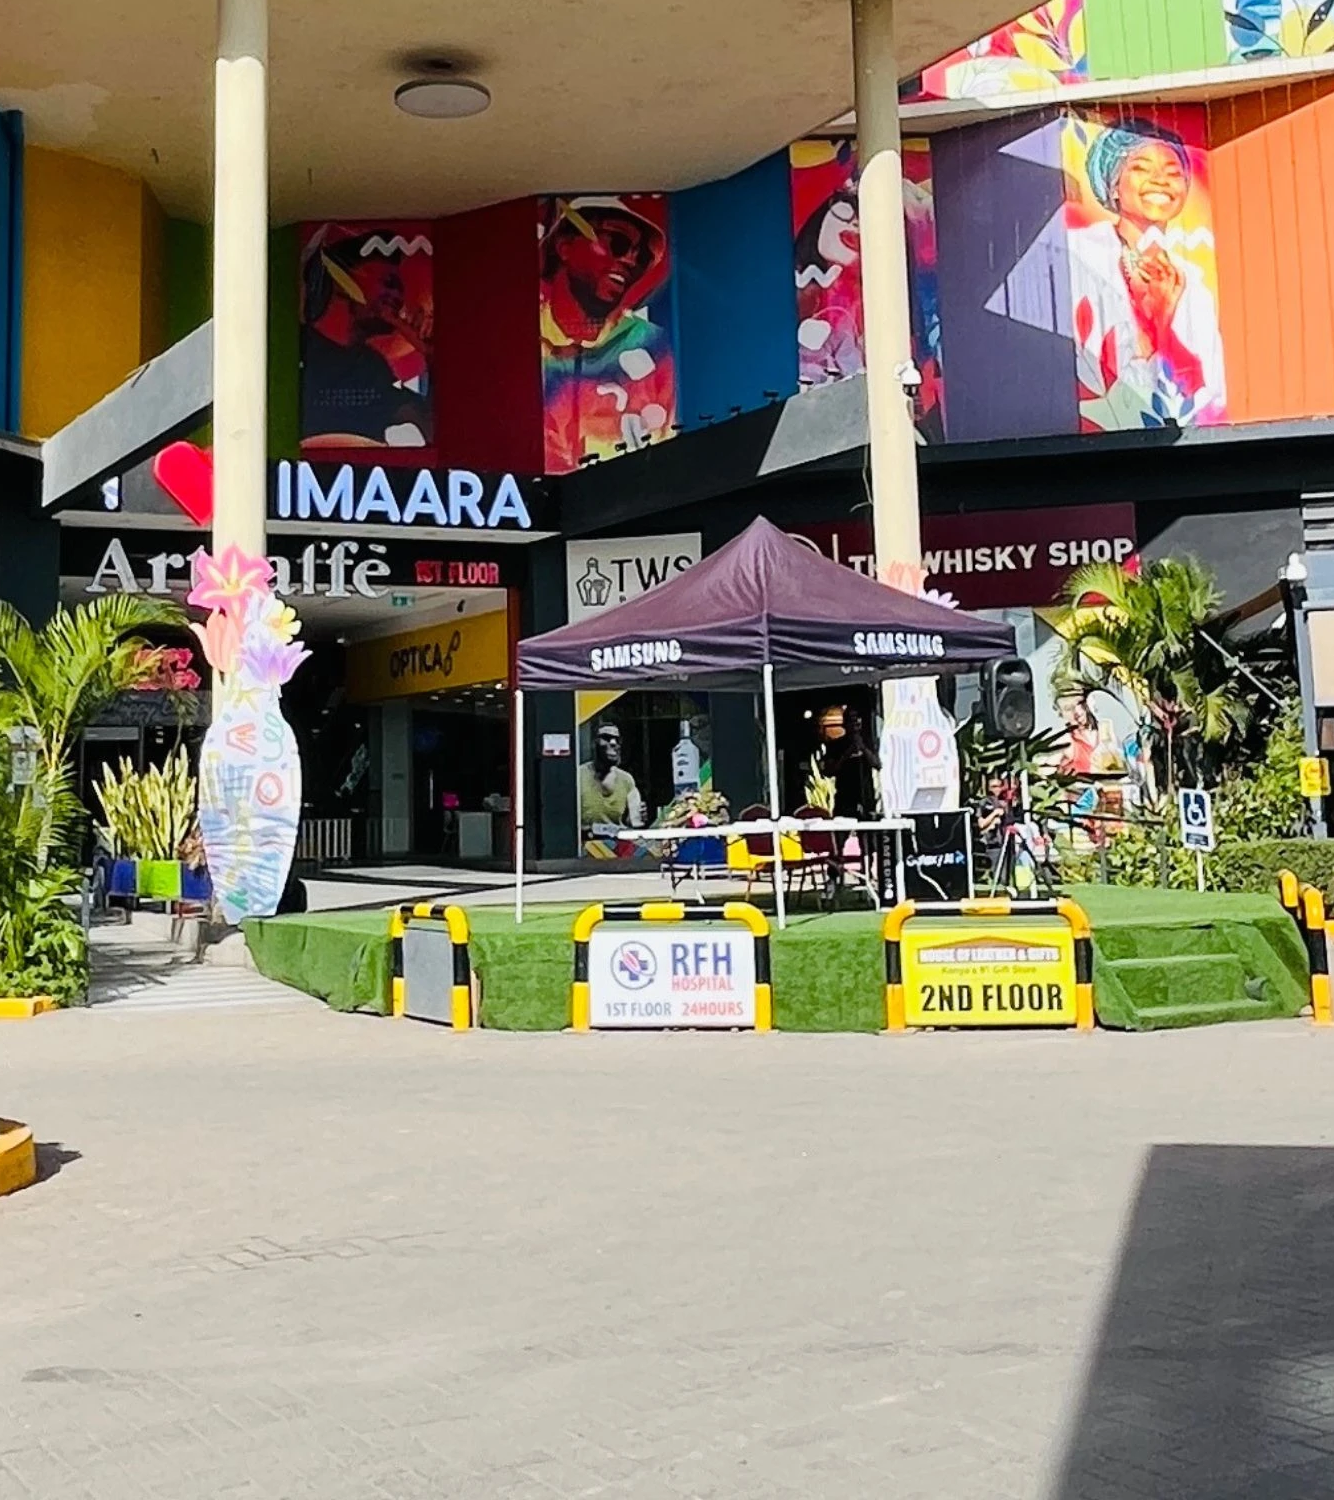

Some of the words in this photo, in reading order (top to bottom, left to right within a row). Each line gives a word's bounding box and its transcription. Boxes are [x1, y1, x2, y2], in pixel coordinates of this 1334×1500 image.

[278, 460, 532, 528] IMAARA
[449, 561, 499, 584] FLOOR
[848, 554, 877, 581] TH
[921, 544, 1037, 576] WHISKY
[1048, 537, 1135, 567] SHOP
[590, 639, 683, 672] SAMSUNG
[853, 632, 945, 657] SAMSUNG
[390, 642, 443, 678] OPTICA
[671, 943, 732, 975] RFH
[671, 976, 735, 991] HOSPITAL
[921, 984, 973, 1012] 2ND
[982, 984, 1064, 1012] FLOOR
[606, 1002, 627, 1016] 1ST
[630, 1002, 672, 1017] FLOOR
[682, 1001, 744, 1017] 24HOURS
